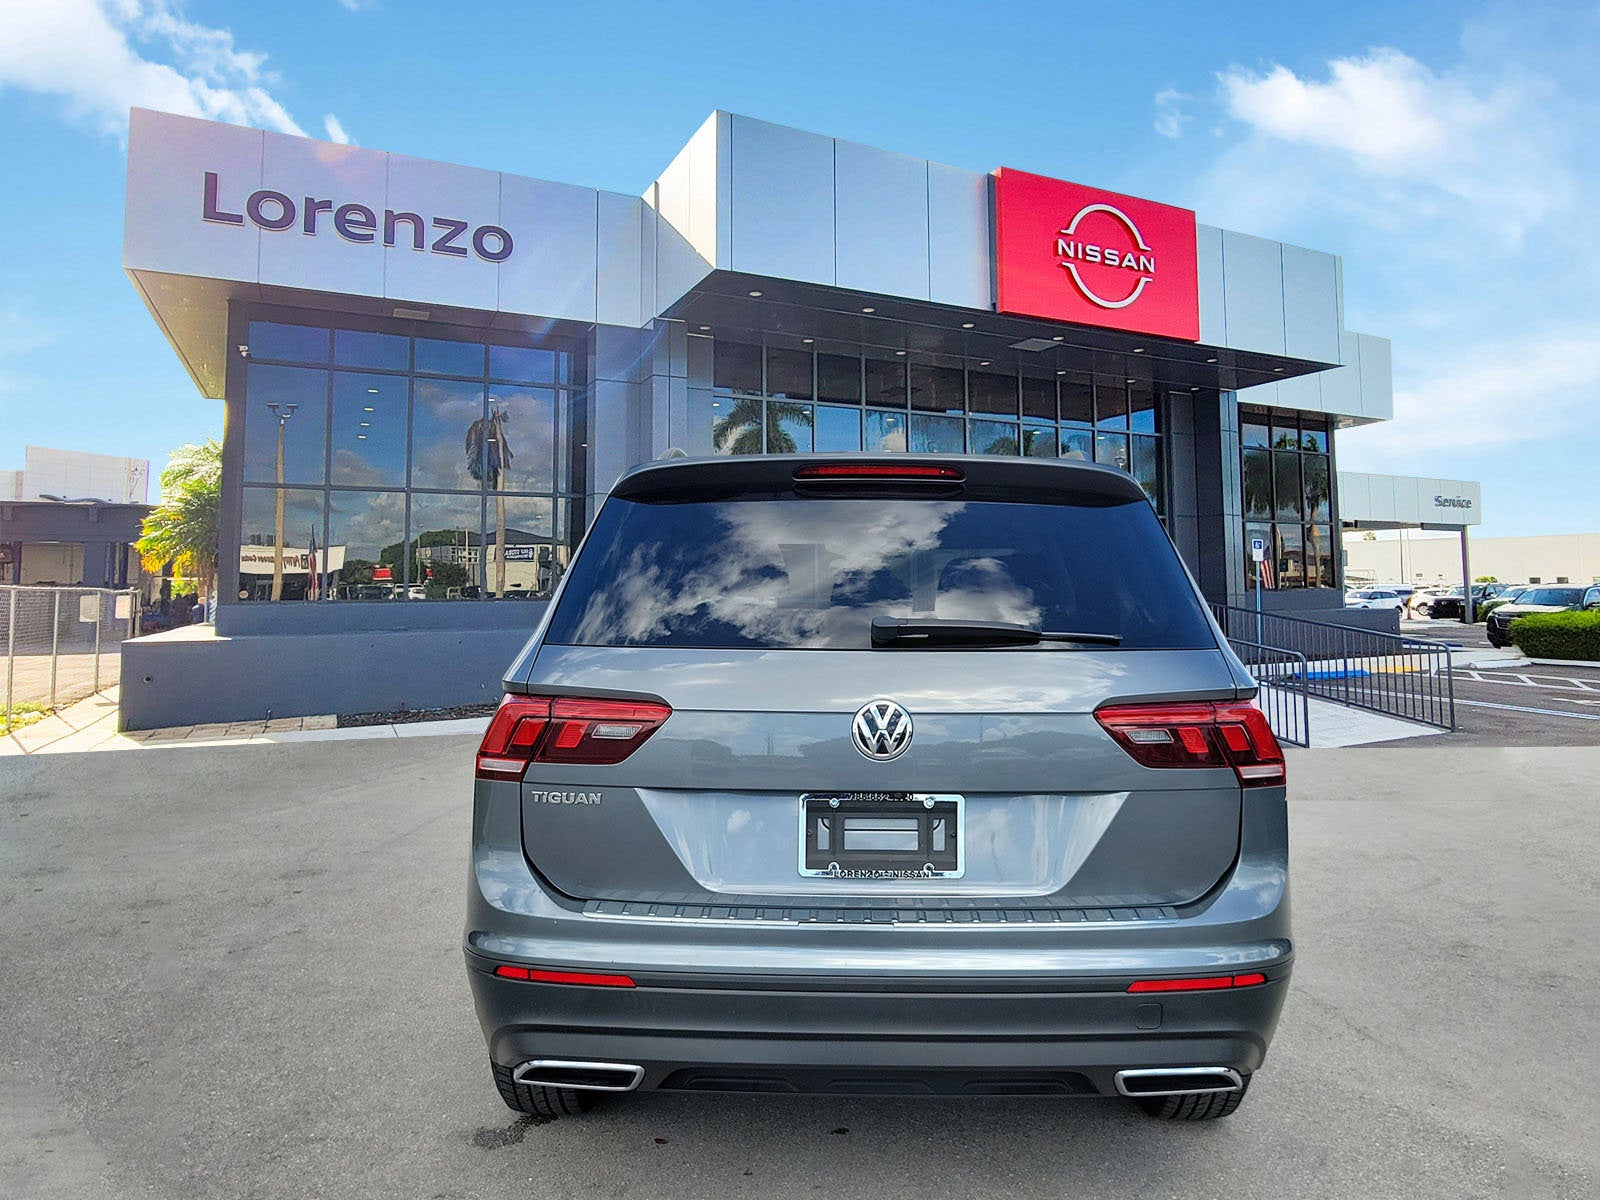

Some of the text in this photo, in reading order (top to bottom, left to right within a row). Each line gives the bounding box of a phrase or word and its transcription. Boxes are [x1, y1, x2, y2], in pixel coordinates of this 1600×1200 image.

[202, 171, 514, 263] Lorenzo
[1057, 238, 1155, 273] NISSAN
[1434, 494, 1472, 509] Service
[531, 790, 602, 805] TIGUAN
[833, 870, 930, 878] LORENZO NISSAN
